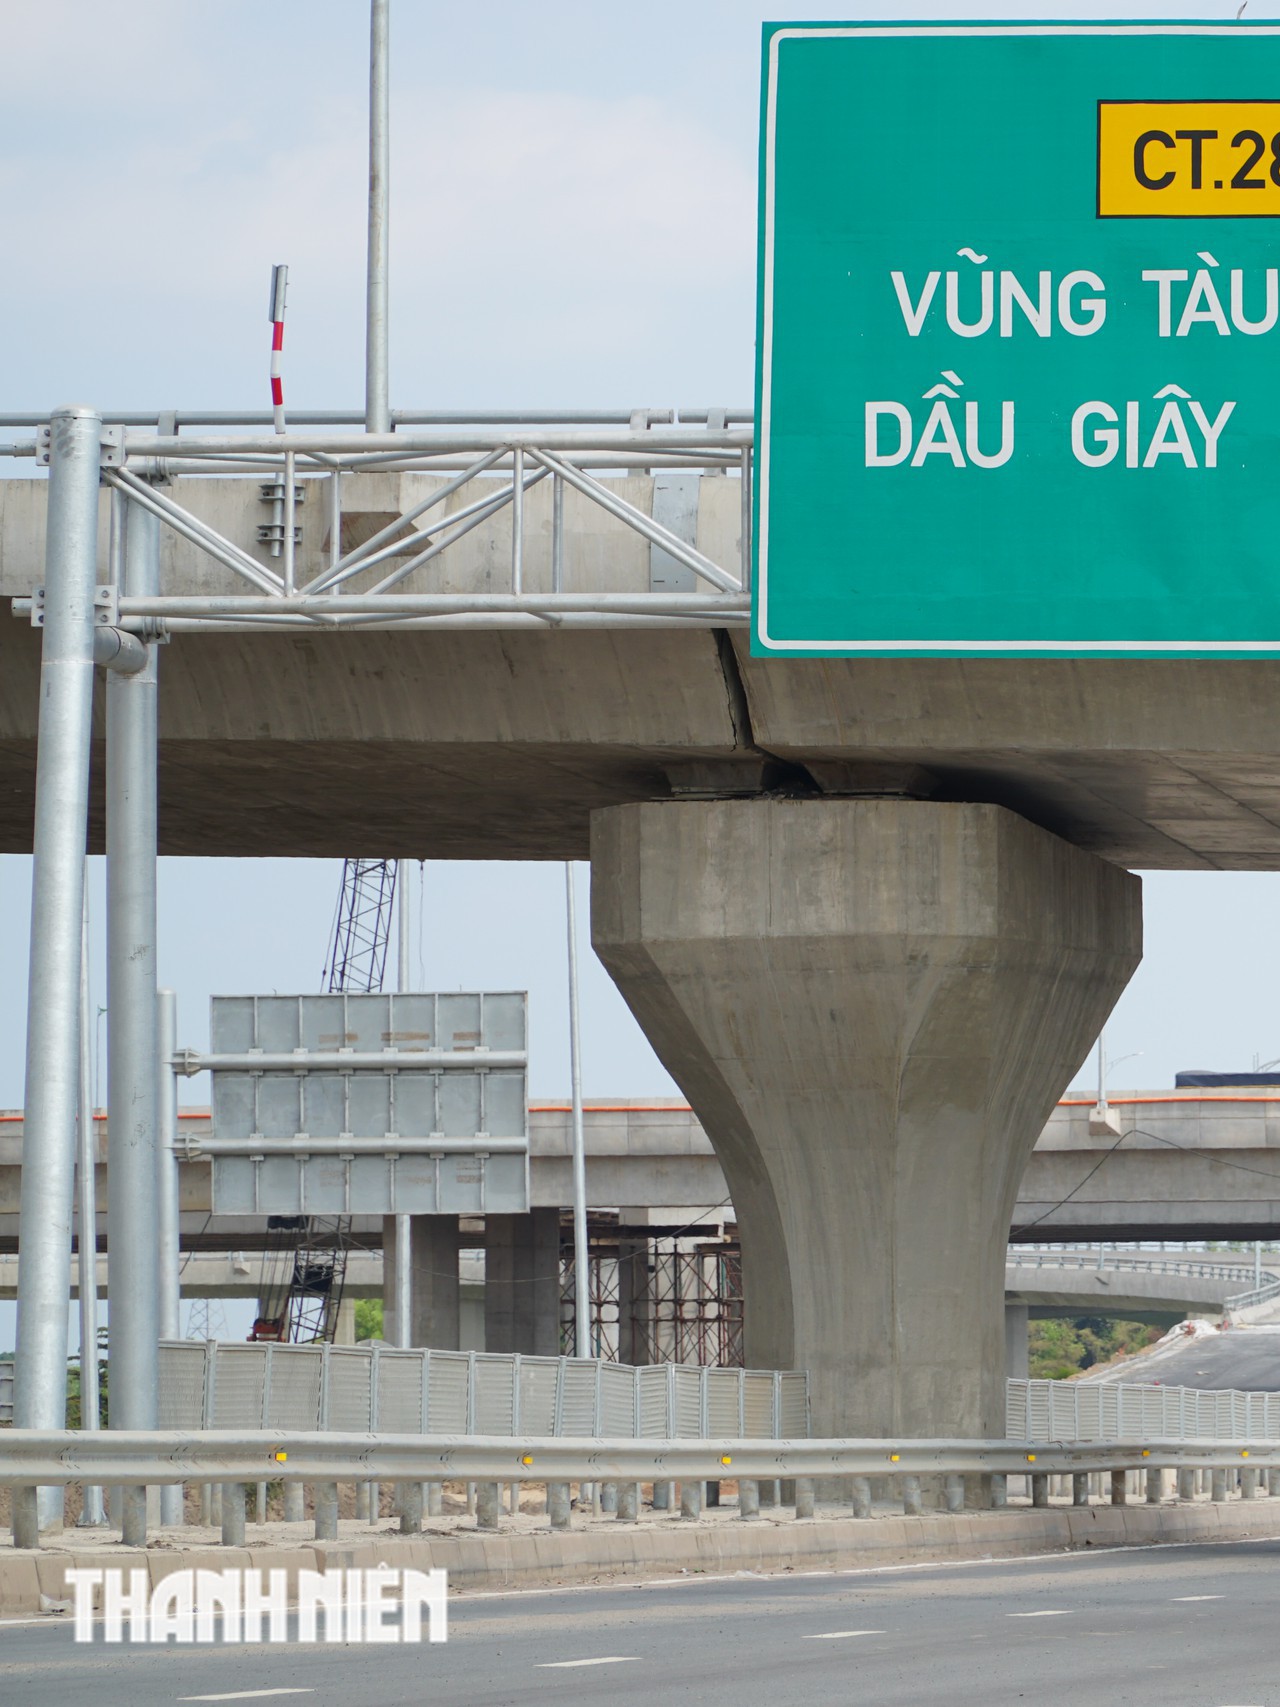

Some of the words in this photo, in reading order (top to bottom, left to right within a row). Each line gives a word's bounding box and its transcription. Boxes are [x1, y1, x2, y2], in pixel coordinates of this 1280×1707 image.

[890, 247, 1107, 338] VŨNG
[1142, 251, 1279, 336] TÀU
[865, 370, 1015, 468] DẦU
[1071, 384, 1238, 468] GIÂY
